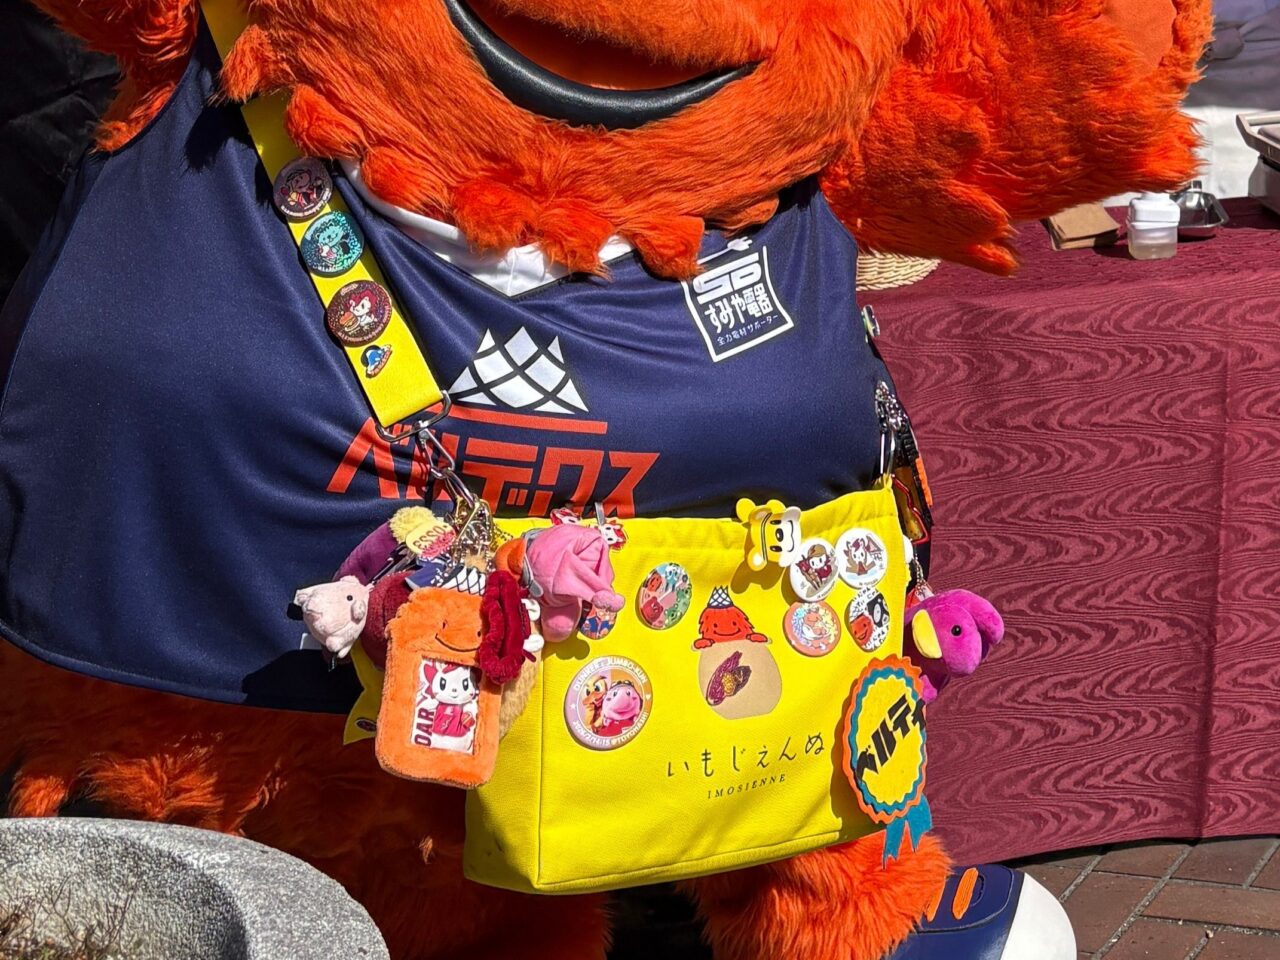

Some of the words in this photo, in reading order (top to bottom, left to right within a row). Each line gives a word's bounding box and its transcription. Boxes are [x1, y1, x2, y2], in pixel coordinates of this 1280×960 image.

[704, 282, 774, 334] すみや電器
[667, 732, 825, 778] いもじえんぬ
[707, 773, 787, 800] IMOSIENNE
